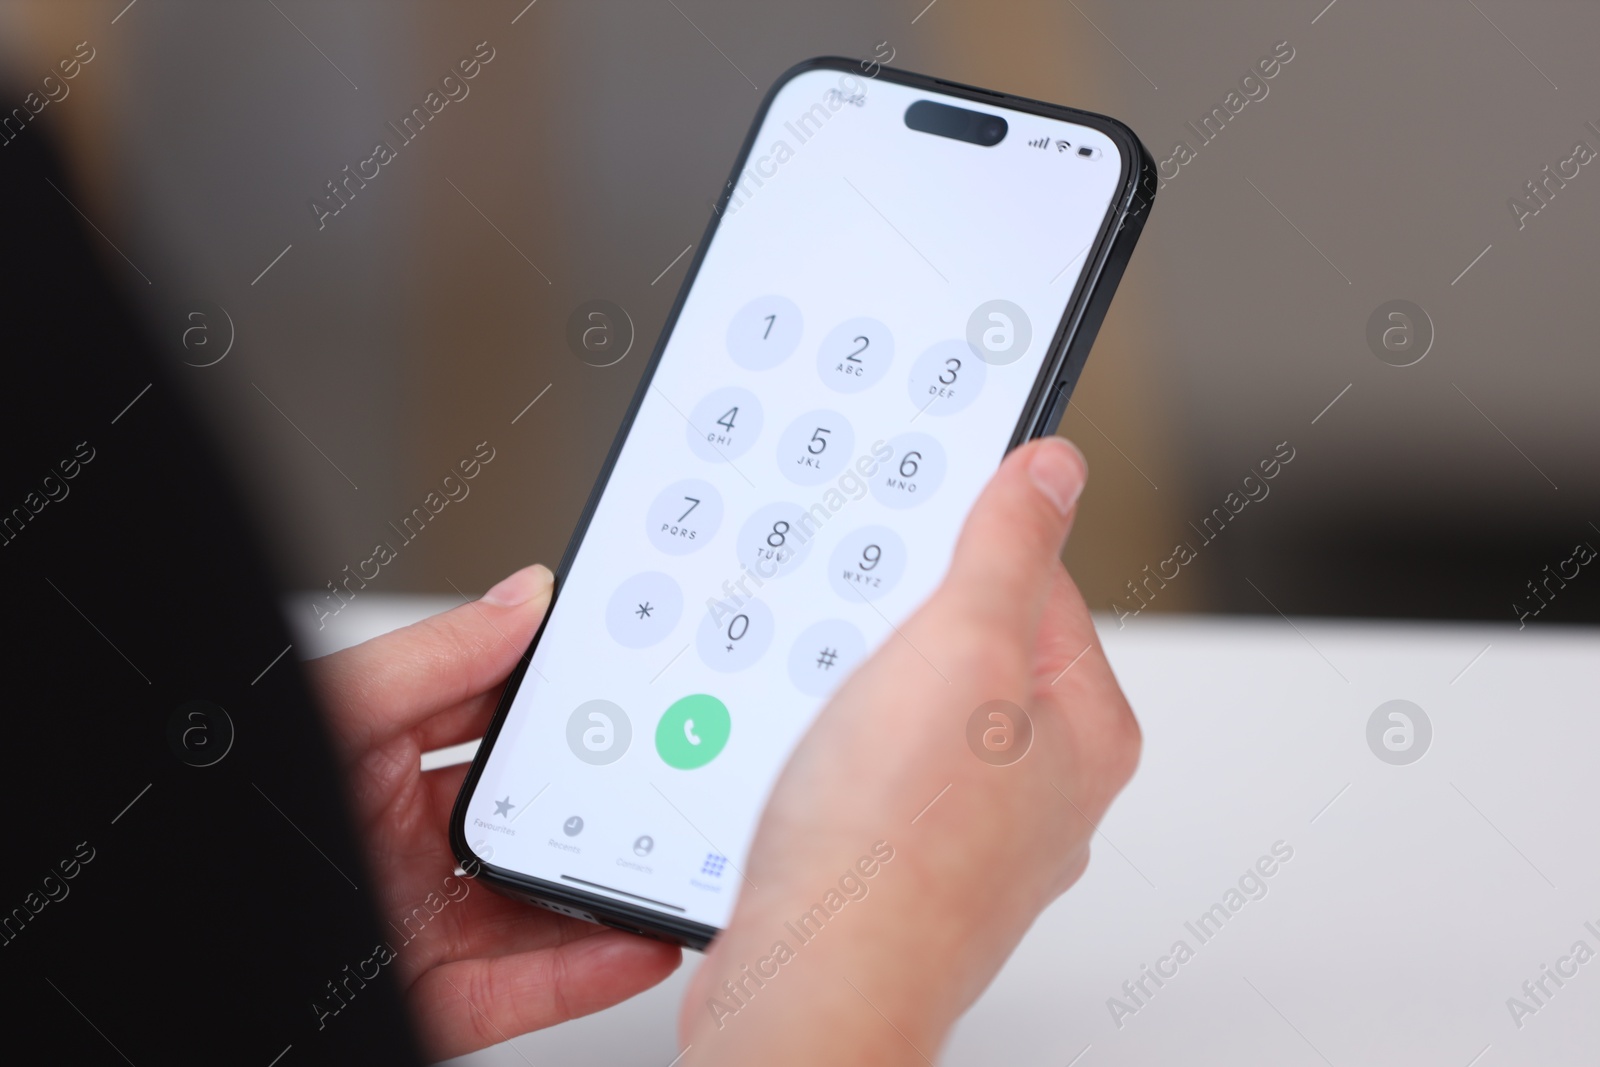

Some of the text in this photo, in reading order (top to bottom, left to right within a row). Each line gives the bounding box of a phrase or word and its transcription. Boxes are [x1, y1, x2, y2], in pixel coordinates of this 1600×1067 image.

[764, 314, 777, 340] 1
[846, 335, 870, 364] 2
[835, 363, 864, 377] ABC
[938, 358, 962, 386] 3
[928, 385, 956, 400] DEF
[716, 406, 739, 433] 4
[707, 432, 732, 447] GHI
[807, 427, 831, 456] 5
[797, 455, 822, 470] JKL
[899, 451, 923, 478] 6
[886, 478, 918, 494] MNO
[677, 496, 701, 524] 7
[661, 523, 698, 541] PQRS
[766, 520, 790, 548] 8
[757, 547, 784, 563] TUV
[858, 544, 882, 572] 9
[842, 569, 882, 589] WXYZ
[727, 614, 750, 642] 0
[473, 817, 517, 838] Favourites
[547, 838, 582, 856] Recents
[615, 857, 654, 875] Contacts
